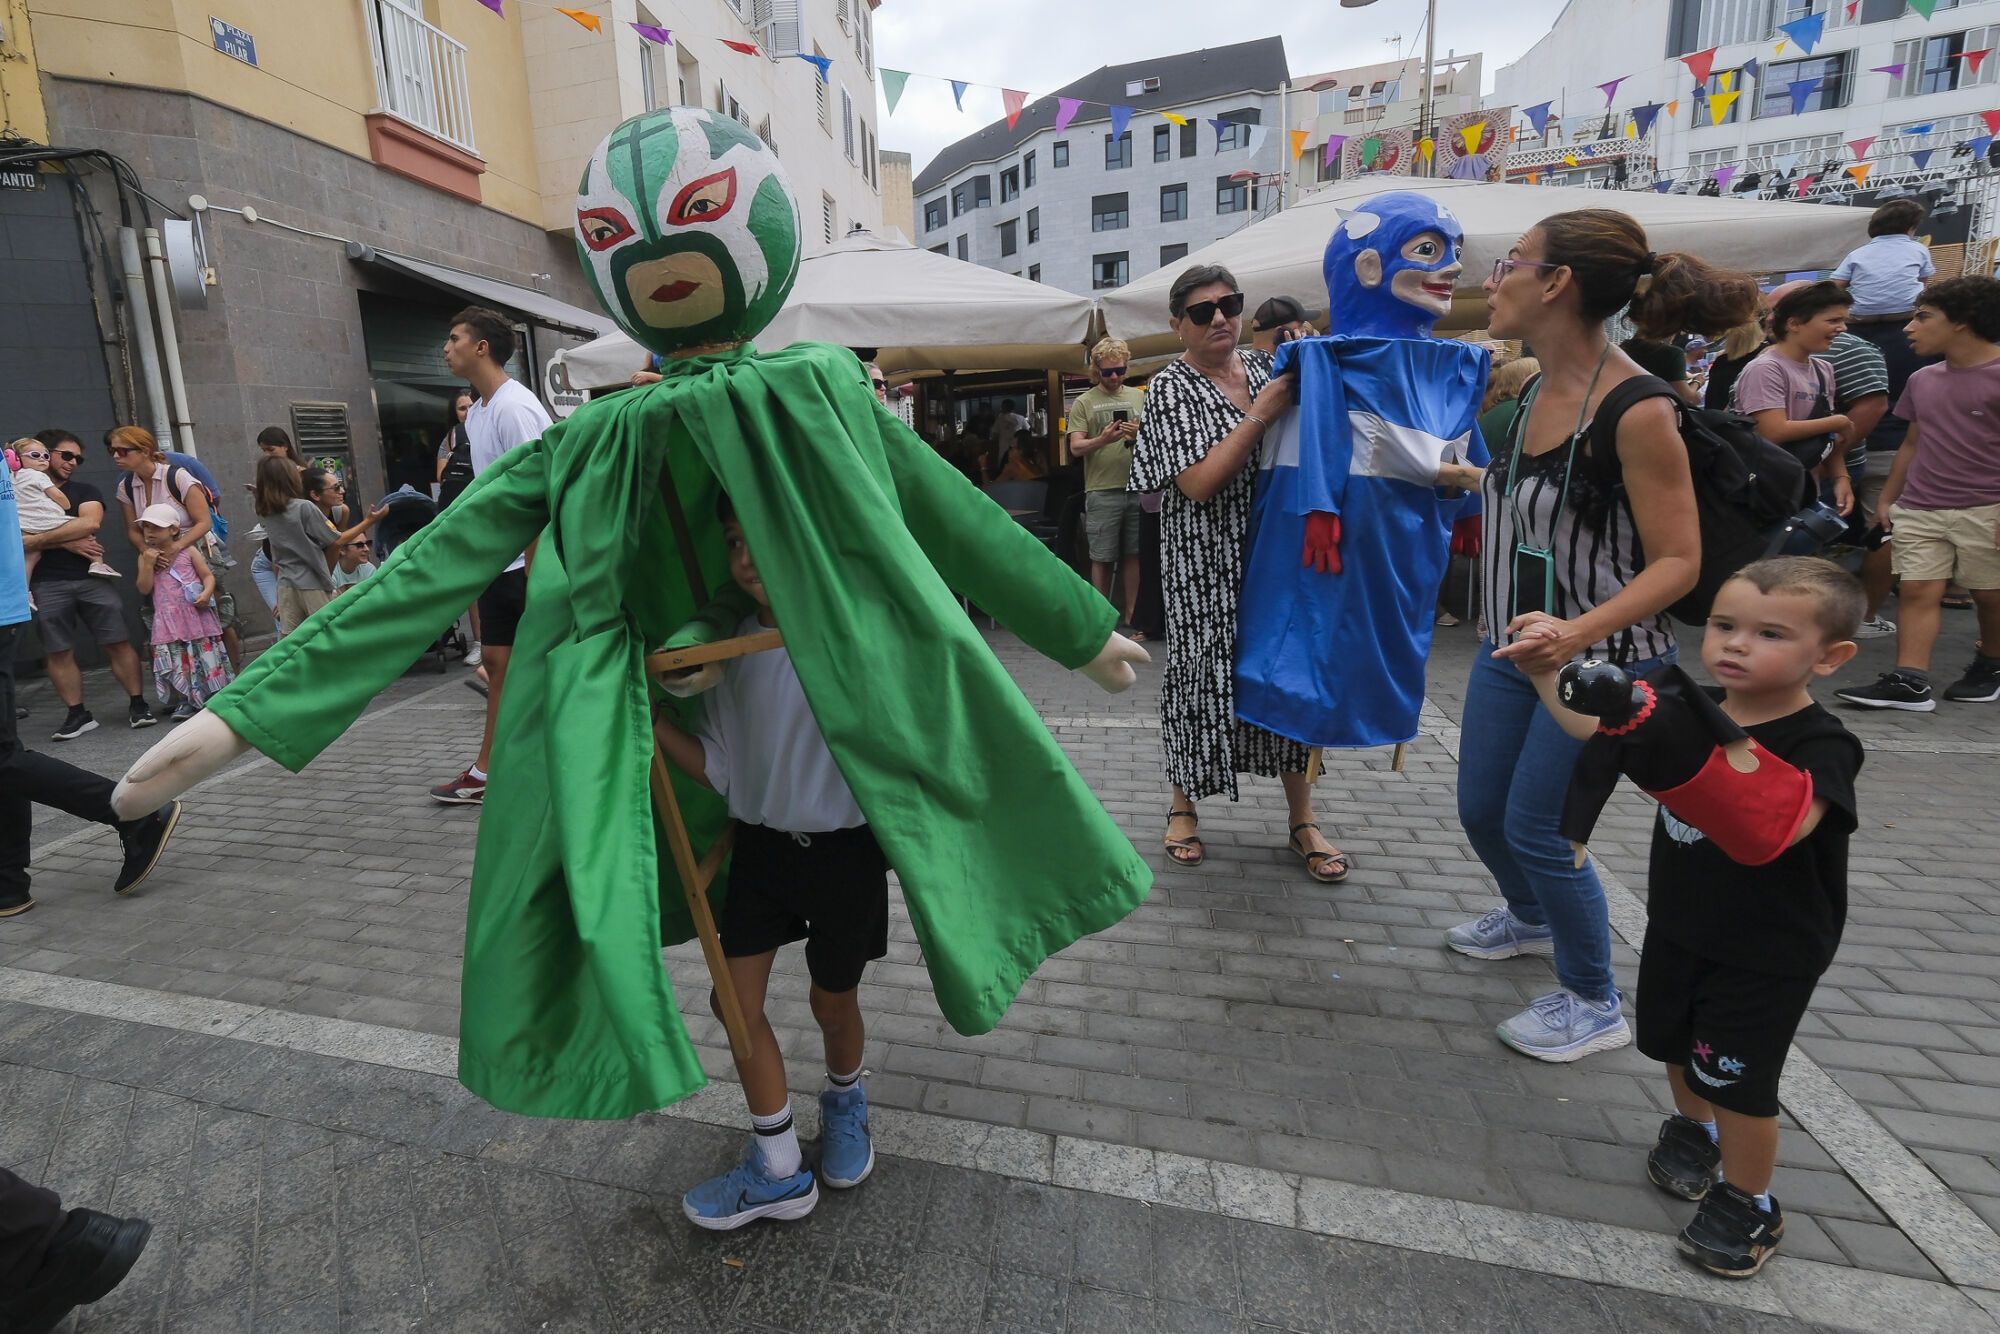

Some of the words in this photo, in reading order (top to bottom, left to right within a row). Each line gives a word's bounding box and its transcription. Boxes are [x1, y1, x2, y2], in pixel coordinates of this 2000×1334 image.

[226, 25, 252, 43] PLAZA
[224, 41, 249, 61] PILAR
[0, 172, 35, 188] ANTO
